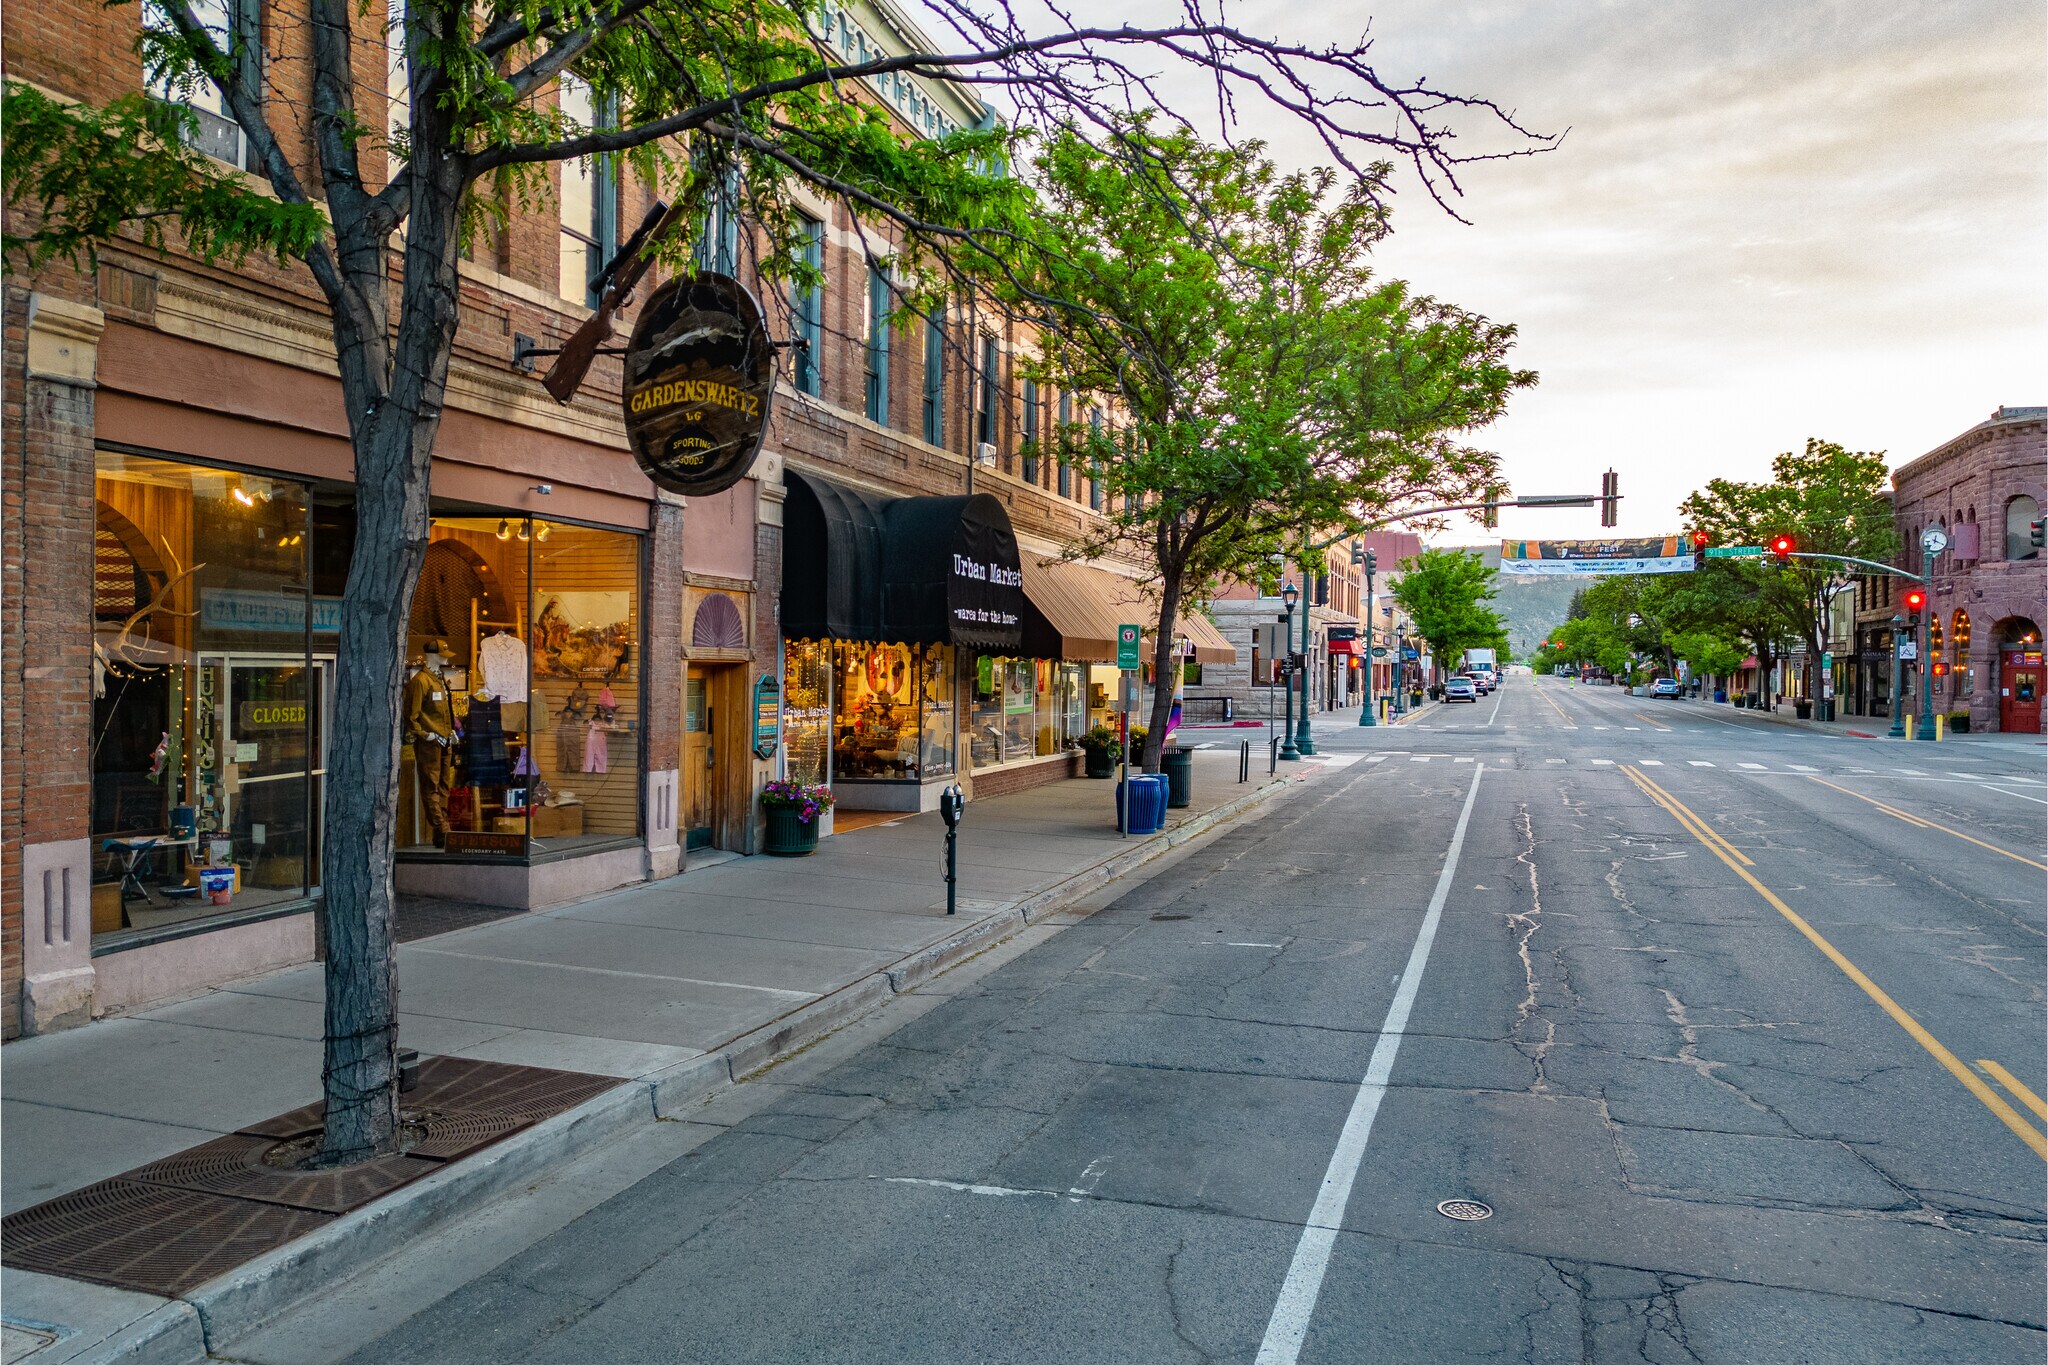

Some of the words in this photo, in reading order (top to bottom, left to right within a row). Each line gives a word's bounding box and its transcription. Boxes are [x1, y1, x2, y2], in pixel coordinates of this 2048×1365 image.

[631, 380, 759, 416] GARDENSWARTZ
[673, 437, 712, 450] SPORTING
[678, 455, 705, 466] GOODS
[1579, 545, 1620, 553] PLAYFEST
[1729, 547, 1757, 556] STREET
[953, 553, 986, 580] Urban
[990, 563, 1022, 587] Market
[978, 608, 989, 622] for
[990, 610, 1001, 623] the
[200, 667, 214, 769] HUNTING
[253, 707, 306, 723] CLOSED
[449, 834, 521, 848] STETSON
